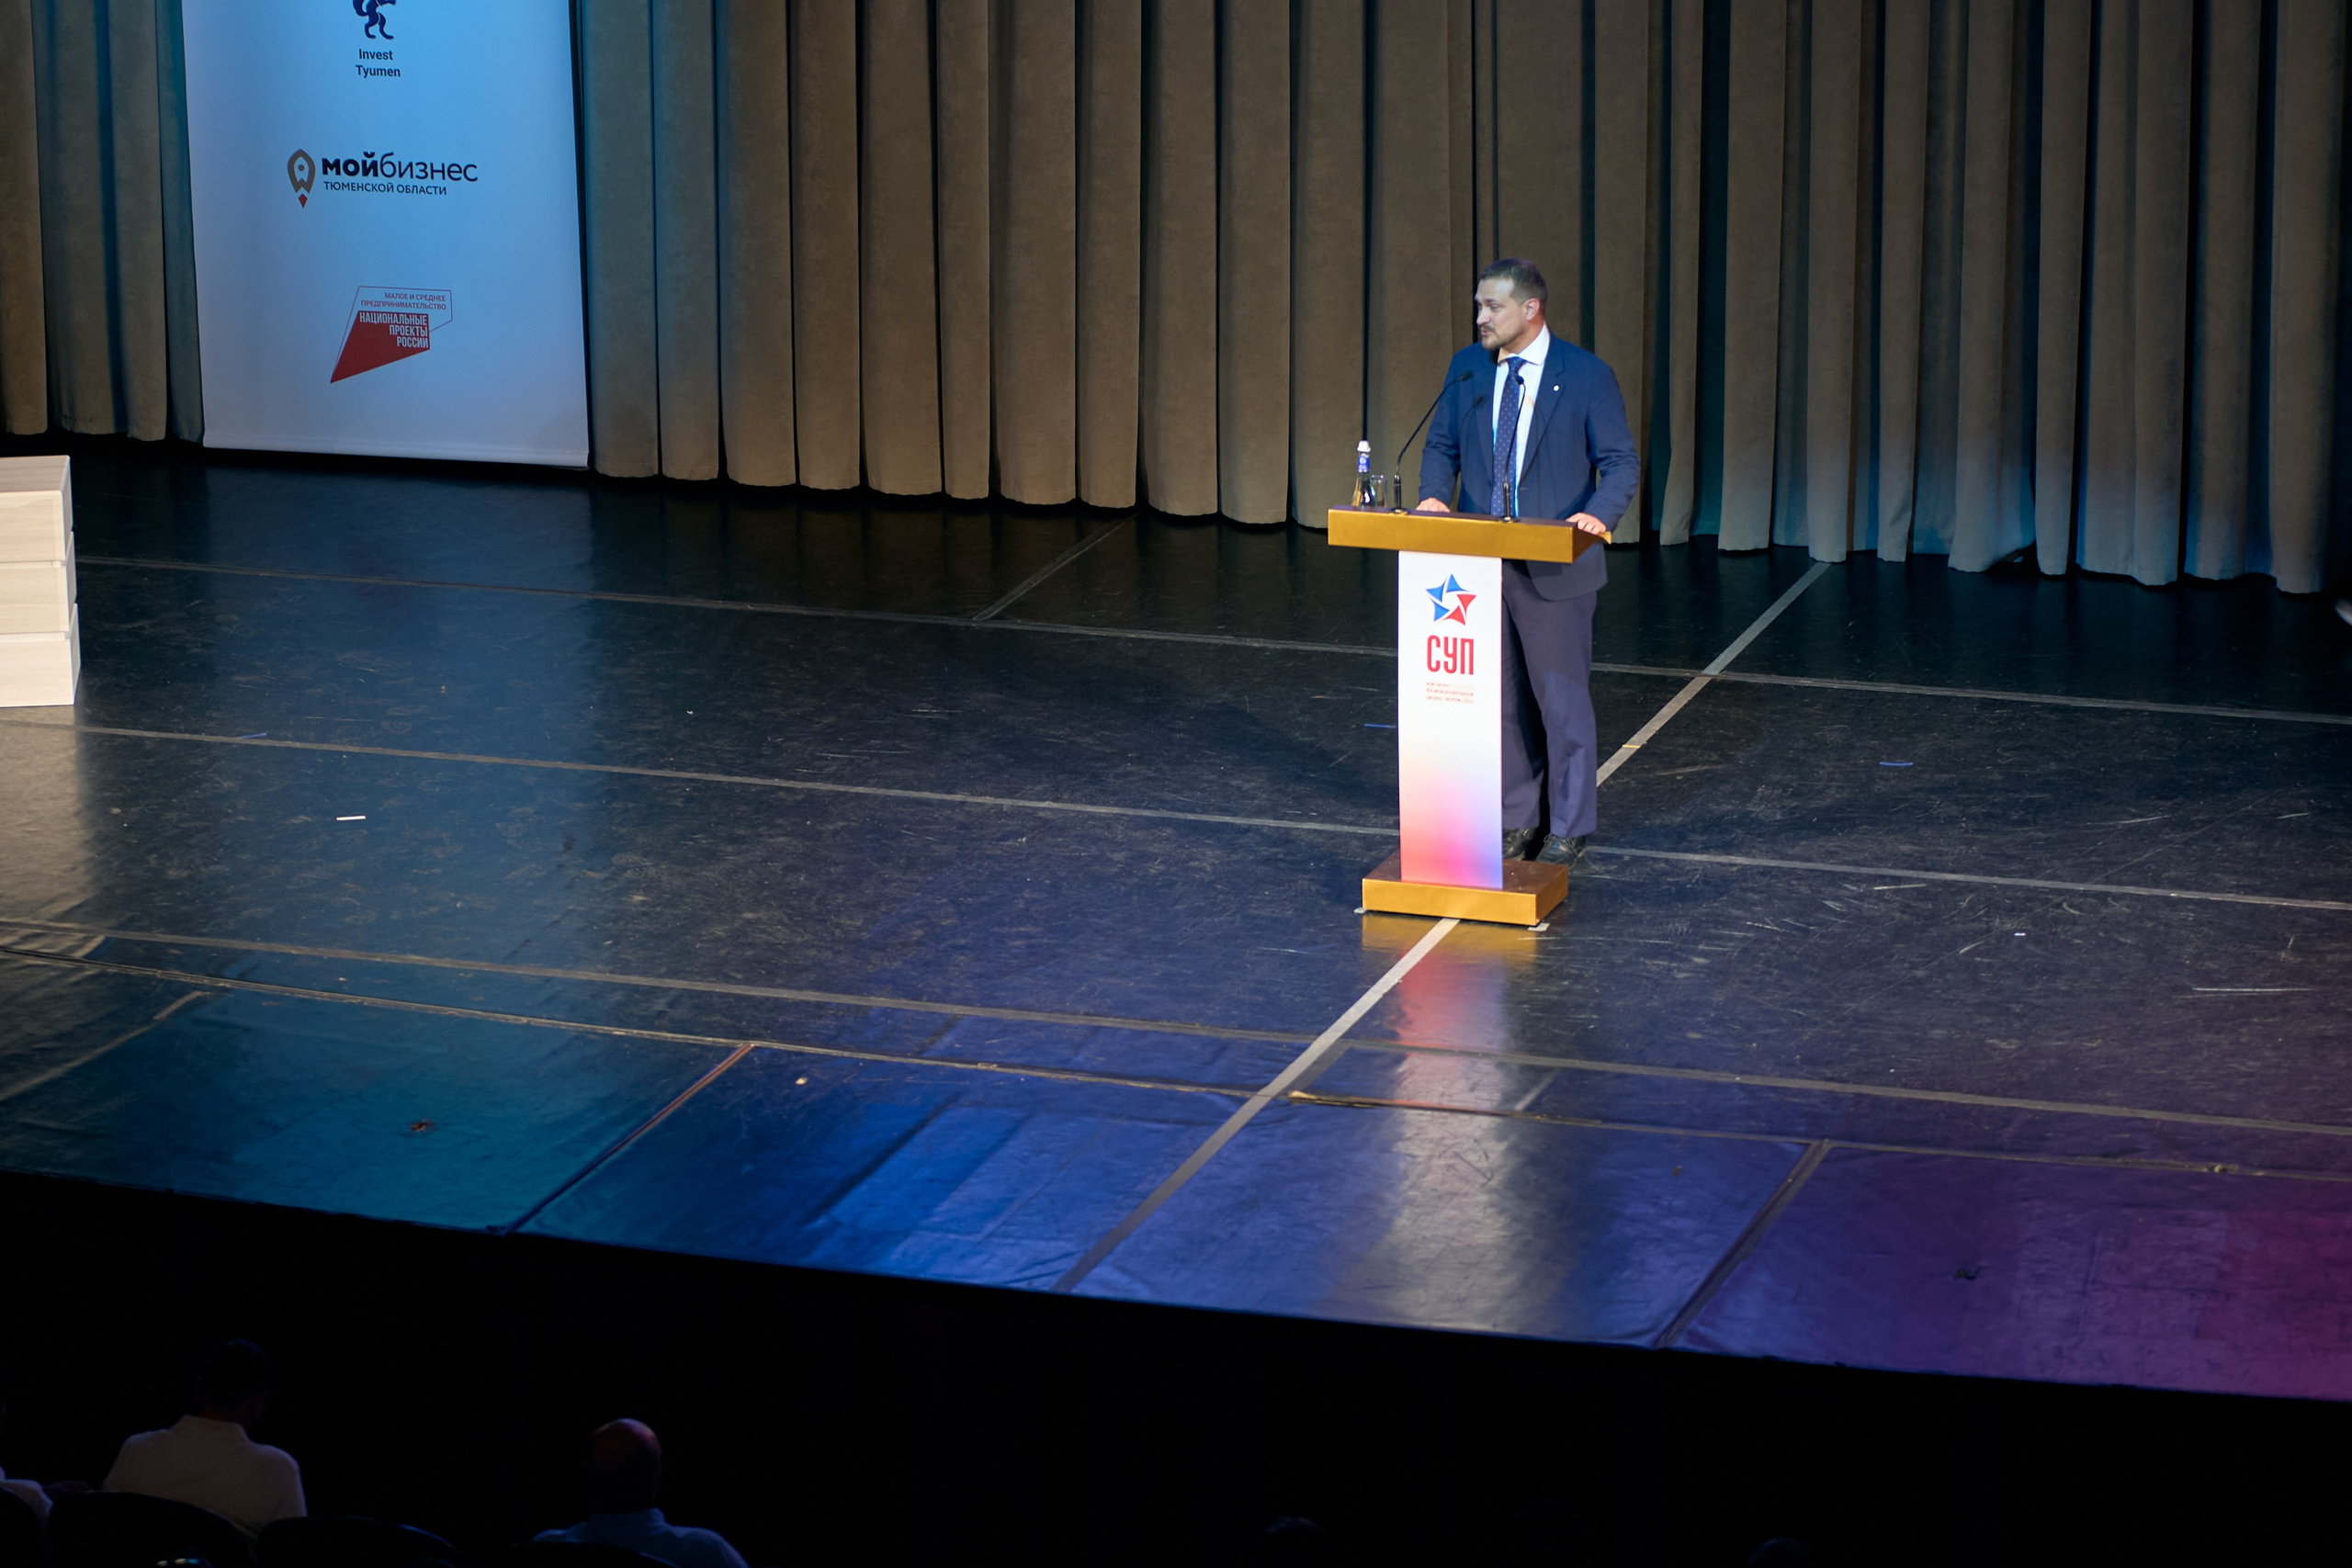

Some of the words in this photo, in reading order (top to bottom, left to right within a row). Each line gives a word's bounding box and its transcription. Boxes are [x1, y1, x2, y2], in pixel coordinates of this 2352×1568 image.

[358, 49, 393, 61] Invest
[356, 64, 401, 78] Tyumen
[323, 181, 394, 193] ТЮМЕНСКОЙ
[396, 184, 447, 196] ОБЛАСТИ
[360, 299, 447, 310] ПРЕДПРИНИМАТЕЛЬСТВО
[359, 312, 427, 325] НАЦИОНАЛЬНЫЕ
[389, 325, 428, 336] ПРОЕКТЫ
[397, 336, 428, 348] РОССИИ
[1427, 635, 1475, 675] СУП
